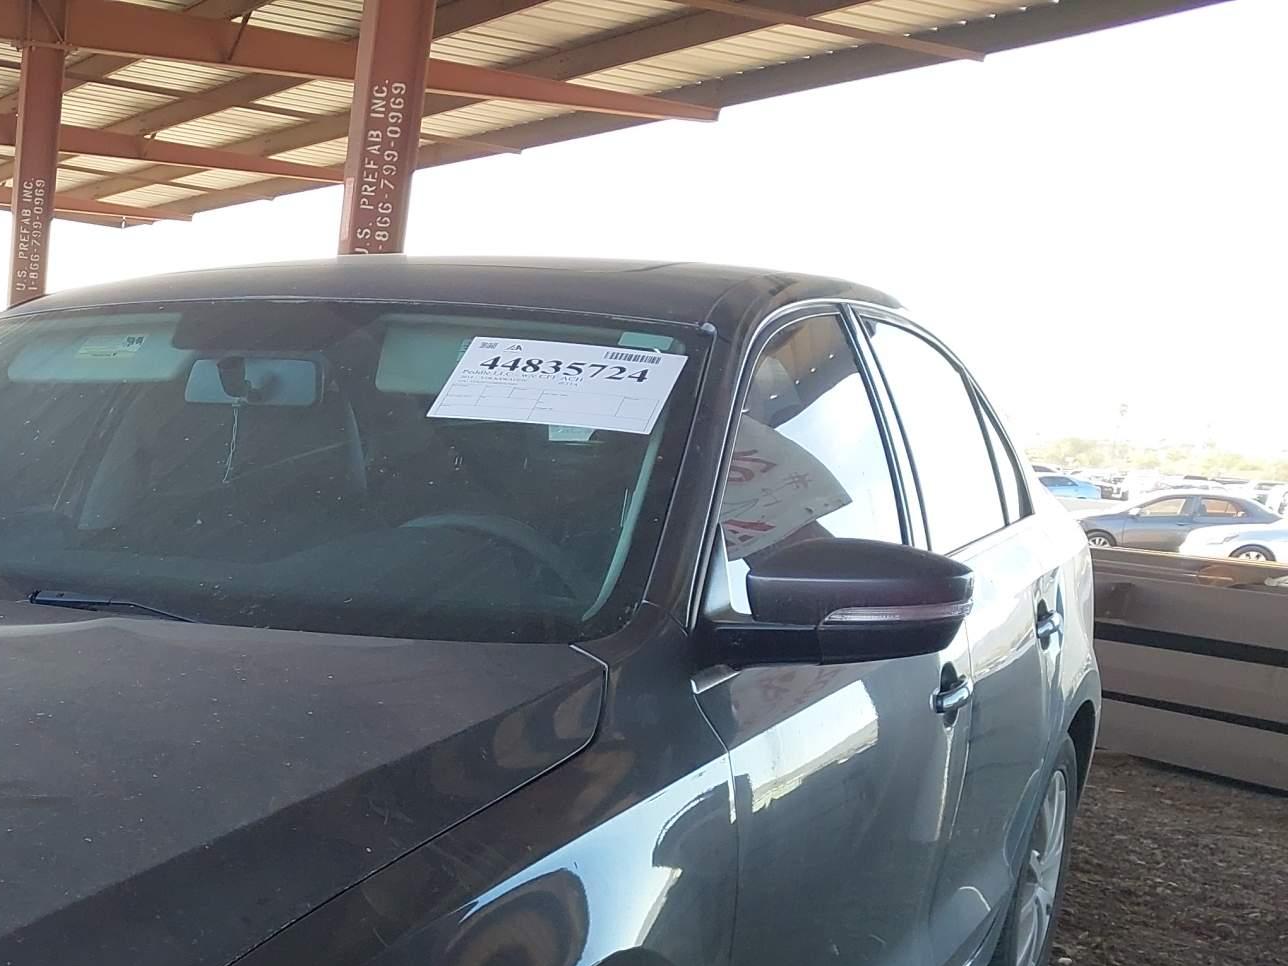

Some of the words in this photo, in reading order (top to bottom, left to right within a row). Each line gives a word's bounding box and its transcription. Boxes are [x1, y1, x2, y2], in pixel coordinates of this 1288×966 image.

[370, 79, 389, 118] INC.
[360, 129, 383, 209] PREFAB
[375, 82, 406, 251] -866-799-0969
[22, 177, 35, 202] INC.
[18, 209, 32, 259] PREFAB
[28, 179, 46, 290] 1-866-799-0969
[16, 267, 28, 291] U.S.
[480, 355, 649, 383] 44835724
